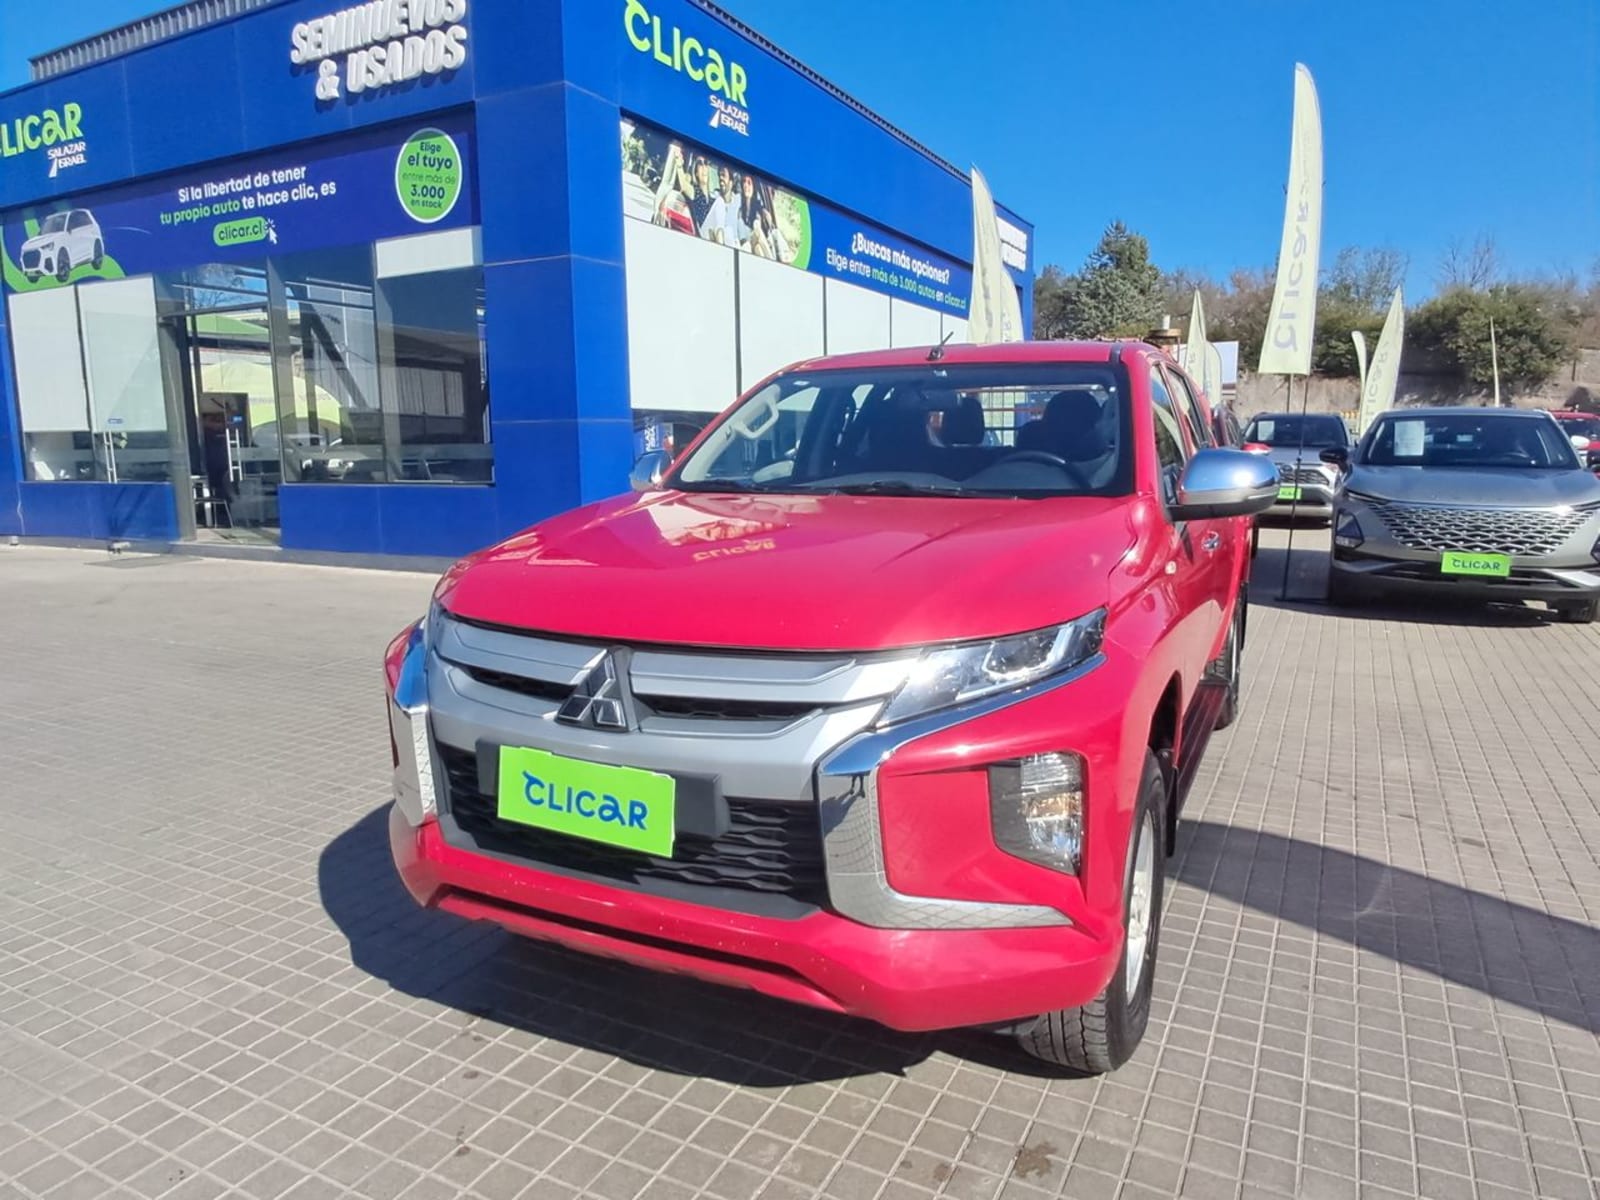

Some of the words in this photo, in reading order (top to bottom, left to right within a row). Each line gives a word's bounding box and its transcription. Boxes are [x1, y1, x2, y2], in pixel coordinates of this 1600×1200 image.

[315, 59, 340, 100] &
[347, 25, 467, 93] USADOS
[709, 94, 750, 125] SALAZAR
[48, 141, 87, 160] SALAZAR
[407, 152, 420, 166] el
[422, 155, 453, 172] tuyo
[420, 141, 442, 154] Elige
[178, 187, 189, 203] Si
[191, 185, 202, 200] la
[204, 175, 251, 198] libertad
[254, 172, 270, 187] de
[272, 166, 307, 185] tener
[411, 184, 446, 199] 3.000
[160, 211, 172, 224] tu
[173, 204, 211, 226] propio
[212, 199, 241, 215] auto
[241, 196, 255, 209] te
[257, 190, 289, 208] hace
[291, 182, 319, 201] clic,
[320, 181, 336, 196] es
[218, 220, 263, 241] clicar.cl
[826, 248, 848, 272] Elige
[849, 259, 871, 278] entre
[851, 232, 891, 263] ¿Buscas
[892, 250, 911, 270] más
[911, 258, 950, 285] opciones?
